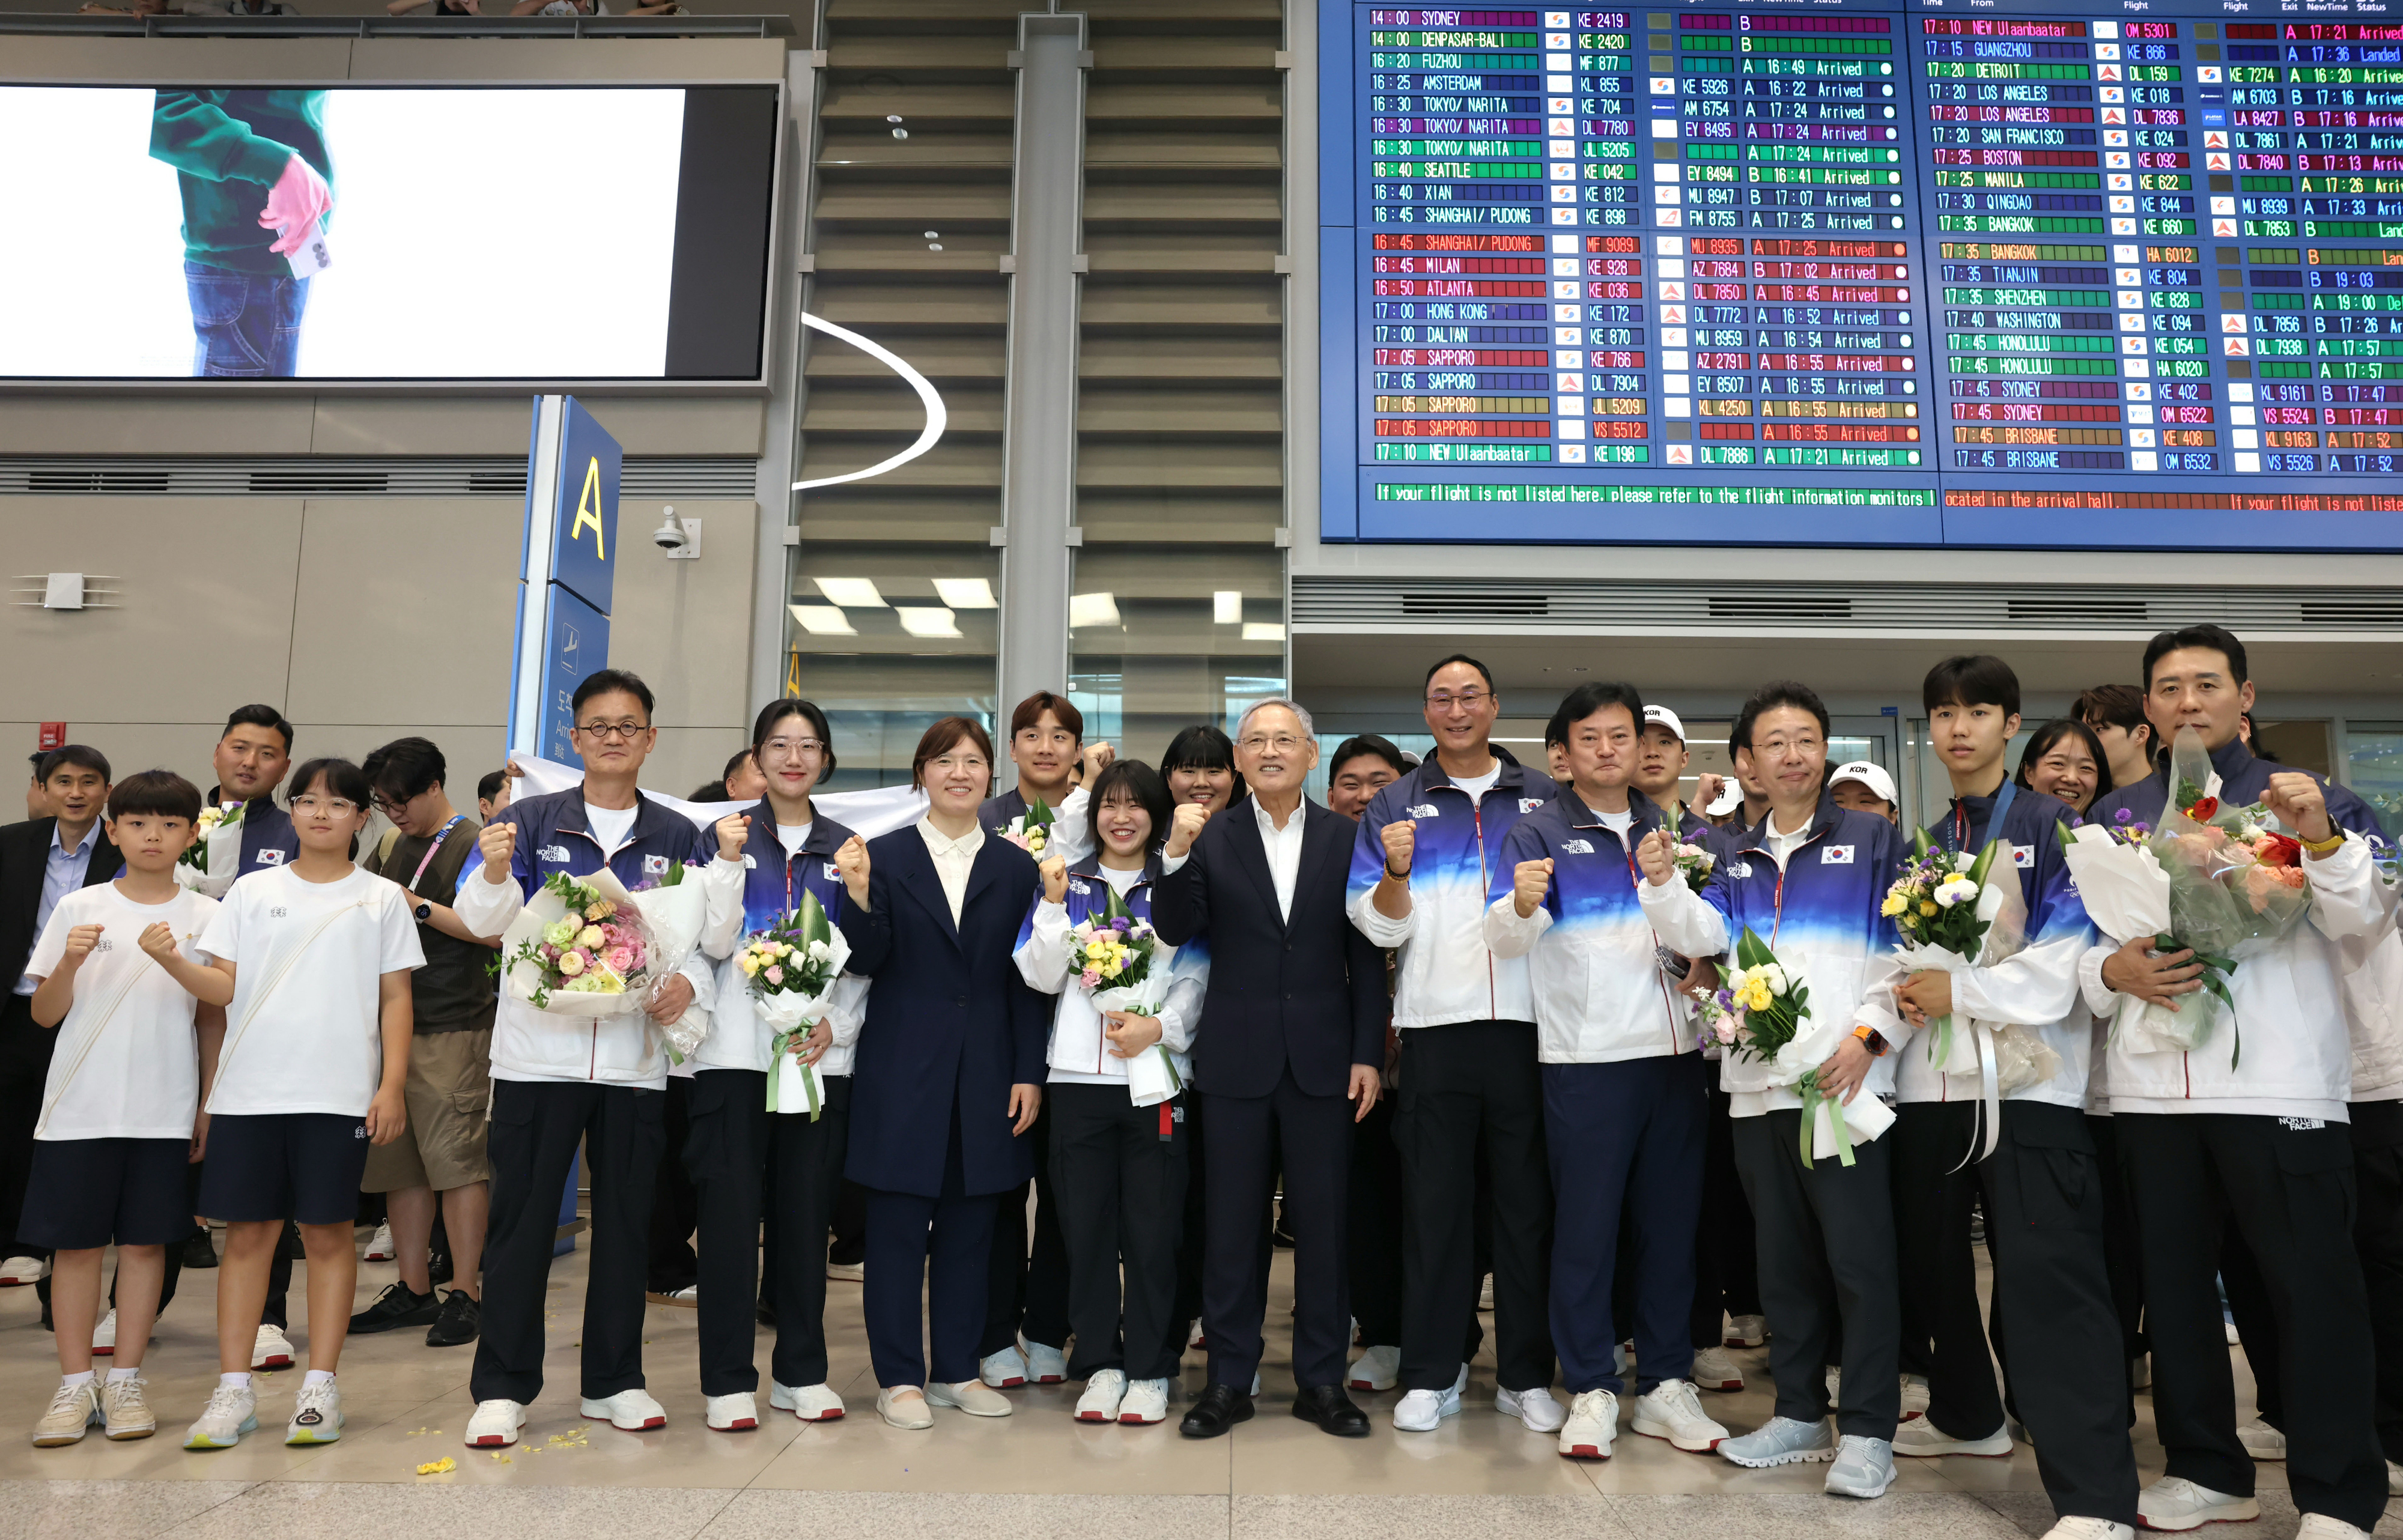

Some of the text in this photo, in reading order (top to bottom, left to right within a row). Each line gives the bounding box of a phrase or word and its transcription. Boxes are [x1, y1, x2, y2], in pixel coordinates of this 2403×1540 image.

[2124, 1, 2148, 11] Flight
[2224, 2, 2248, 11] Flight
[1421, 11, 1623, 28] SYDNEY KE 2419
[1973, 20, 1991, 35] NEW
[1997, 21, 2066, 36] Ulaanbaatar
[1422, 32, 1504, 48] DENPASAR-BALI
[1975, 42, 2400, 62] GUANGZHOU Landed
[1422, 53, 1861, 76] FUZHOU Arrived
[1976, 64, 2020, 79] DETROIT
[1423, 76, 1620, 92] AMSTERDAM KL 855
[1978, 85, 2047, 101] LOS ANGELES
[1468, 97, 1508, 112] NARITA
[1979, 106, 2278, 126] LOS ANGELES LA 8427
[1469, 118, 1508, 134] NARITA
[1582, 121, 1595, 135] DL
[1602, 121, 1628, 136] 7780
[1822, 126, 1867, 141] Arrived
[1982, 128, 2064, 144] SAN FRANCISCO
[1469, 141, 1509, 156] NARITA
[1983, 150, 2022, 165] BOSTON
[1424, 163, 1471, 178] SEATTLE
[1985, 172, 2024, 187] MANILA
[1425, 185, 1451, 201] XIAN
[1987, 194, 2288, 214] QINGDAO MU 8939
[1491, 208, 1531, 223] PUDONG
[1586, 208, 1599, 224] KE
[1605, 209, 1626, 225] 898
[1827, 214, 1873, 229] Arrived
[1988, 216, 2034, 232] BANGKOK
[1492, 235, 1531, 251] PUDONG
[1587, 237, 1600, 252] MF
[1606, 237, 1633, 252] 9089
[1990, 244, 2037, 260] BANGKOK
[1426, 258, 1876, 280] MILAN Arrived
[1993, 267, 2038, 282] TIANJIN
[1427, 280, 1474, 296] ATLANTA
[1994, 290, 2046, 306] SHENZHEN
[1427, 304, 1629, 321] HONG KONG KE 172
[1996, 312, 2061, 329] WASHINGTON
[1427, 327, 1880, 349] DALIAN Arrived
[1998, 335, 2302, 355] HONOLULU DL 7938
[1427, 350, 1475, 366] SAPPORO
[2000, 359, 2052, 374] HONOLULU
[1428, 374, 1638, 390] SAPPORO DL 7904
[2002, 381, 2041, 397] SYDNEY
[1429, 397, 1885, 419] SAPPORO Arrived
[2004, 405, 2042, 420] SYDNEY
[1429, 420, 1477, 436] SAPPORO
[2005, 428, 2312, 447] BRISBANE KL 9163
[1430, 444, 1635, 462] NEW Ulaanbaatar KE 198
[2007, 452, 2059, 468] BRISBANE
[1378, 484, 1389, 500] If
[1396, 488, 1423, 501] your
[1430, 484, 1470, 501] flight
[1479, 487, 1491, 501] is
[1497, 487, 1517, 501] not
[1526, 485, 1565, 502] listed
[1611, 485, 1652, 503] please
[1659, 488, 1692, 503] refer
[1699, 489, 1712, 503] to
[1719, 487, 1739, 504] the
[1746, 488, 1784, 505] flight
[1793, 489, 1864, 505] information
[1870, 490, 1922, 506] monitors
[1945, 491, 1985, 507] ocated
[1992, 492, 2005, 507] in
[2011, 491, 2031, 508] the
[2037, 492, 2080, 508] arrival
[2231, 494, 2403, 511] If your flight is not liste
[571, 456, 604, 560] A
[554, 742, 565, 759] 到达
[2289, 1122, 2312, 1130] FACE
